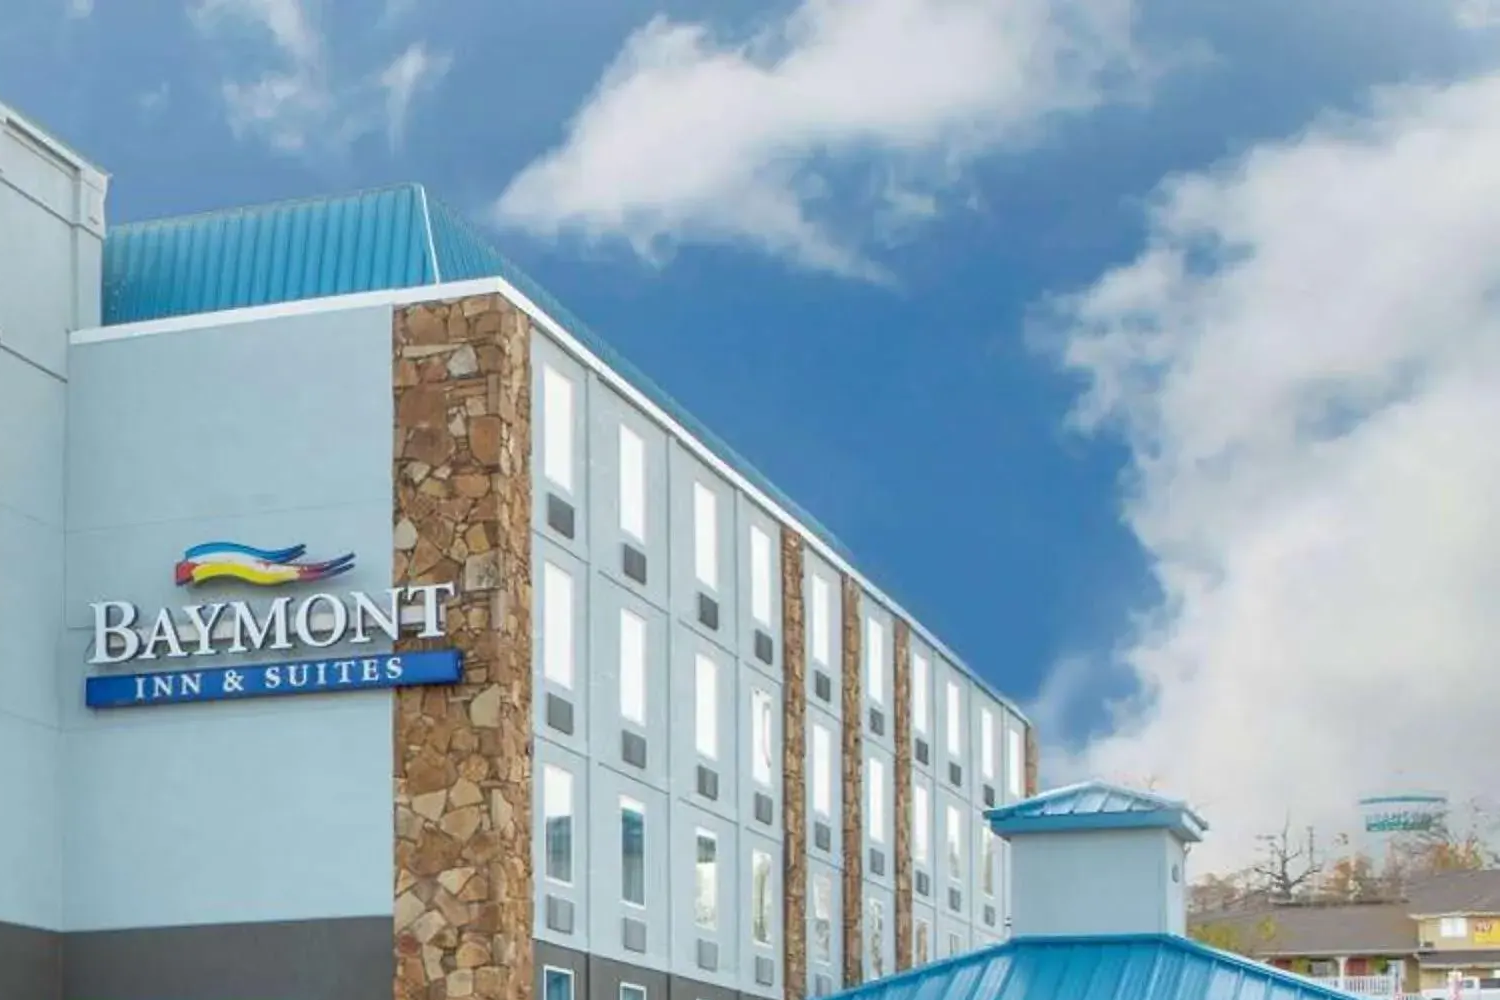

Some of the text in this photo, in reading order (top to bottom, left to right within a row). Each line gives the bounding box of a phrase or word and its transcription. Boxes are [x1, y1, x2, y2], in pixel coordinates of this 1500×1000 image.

[86, 581, 455, 665] BAYMONT
[134, 656, 405, 700] INN & SUITES
